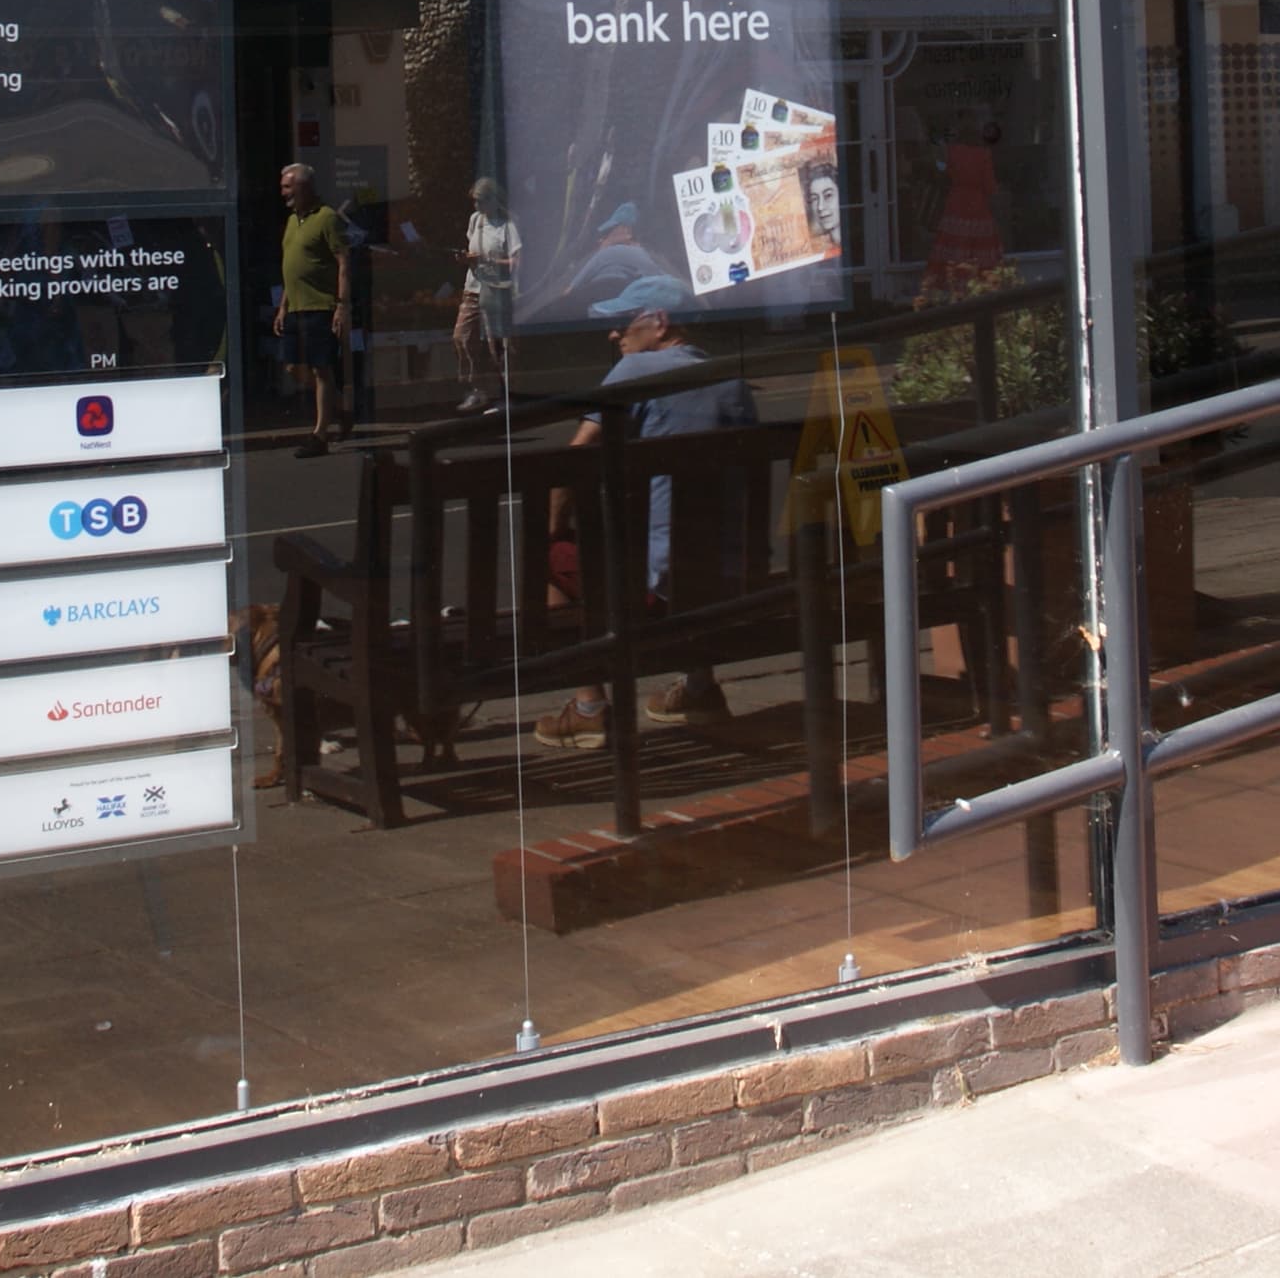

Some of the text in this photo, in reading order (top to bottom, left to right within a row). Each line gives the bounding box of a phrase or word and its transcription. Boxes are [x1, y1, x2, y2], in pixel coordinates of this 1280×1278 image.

[567, 0, 769, 44] bank here
[80, 248, 125, 270] with
[130, 247, 185, 268] these
[47, 271, 142, 300] providers
[147, 274, 179, 292] are
[90, 353, 116, 369] PM
[57, 501, 141, 534] TSB
[66, 596, 160, 623] BARCLAYS
[72, 692, 162, 719] Santander
[41, 817, 85, 832] LLOYDS
